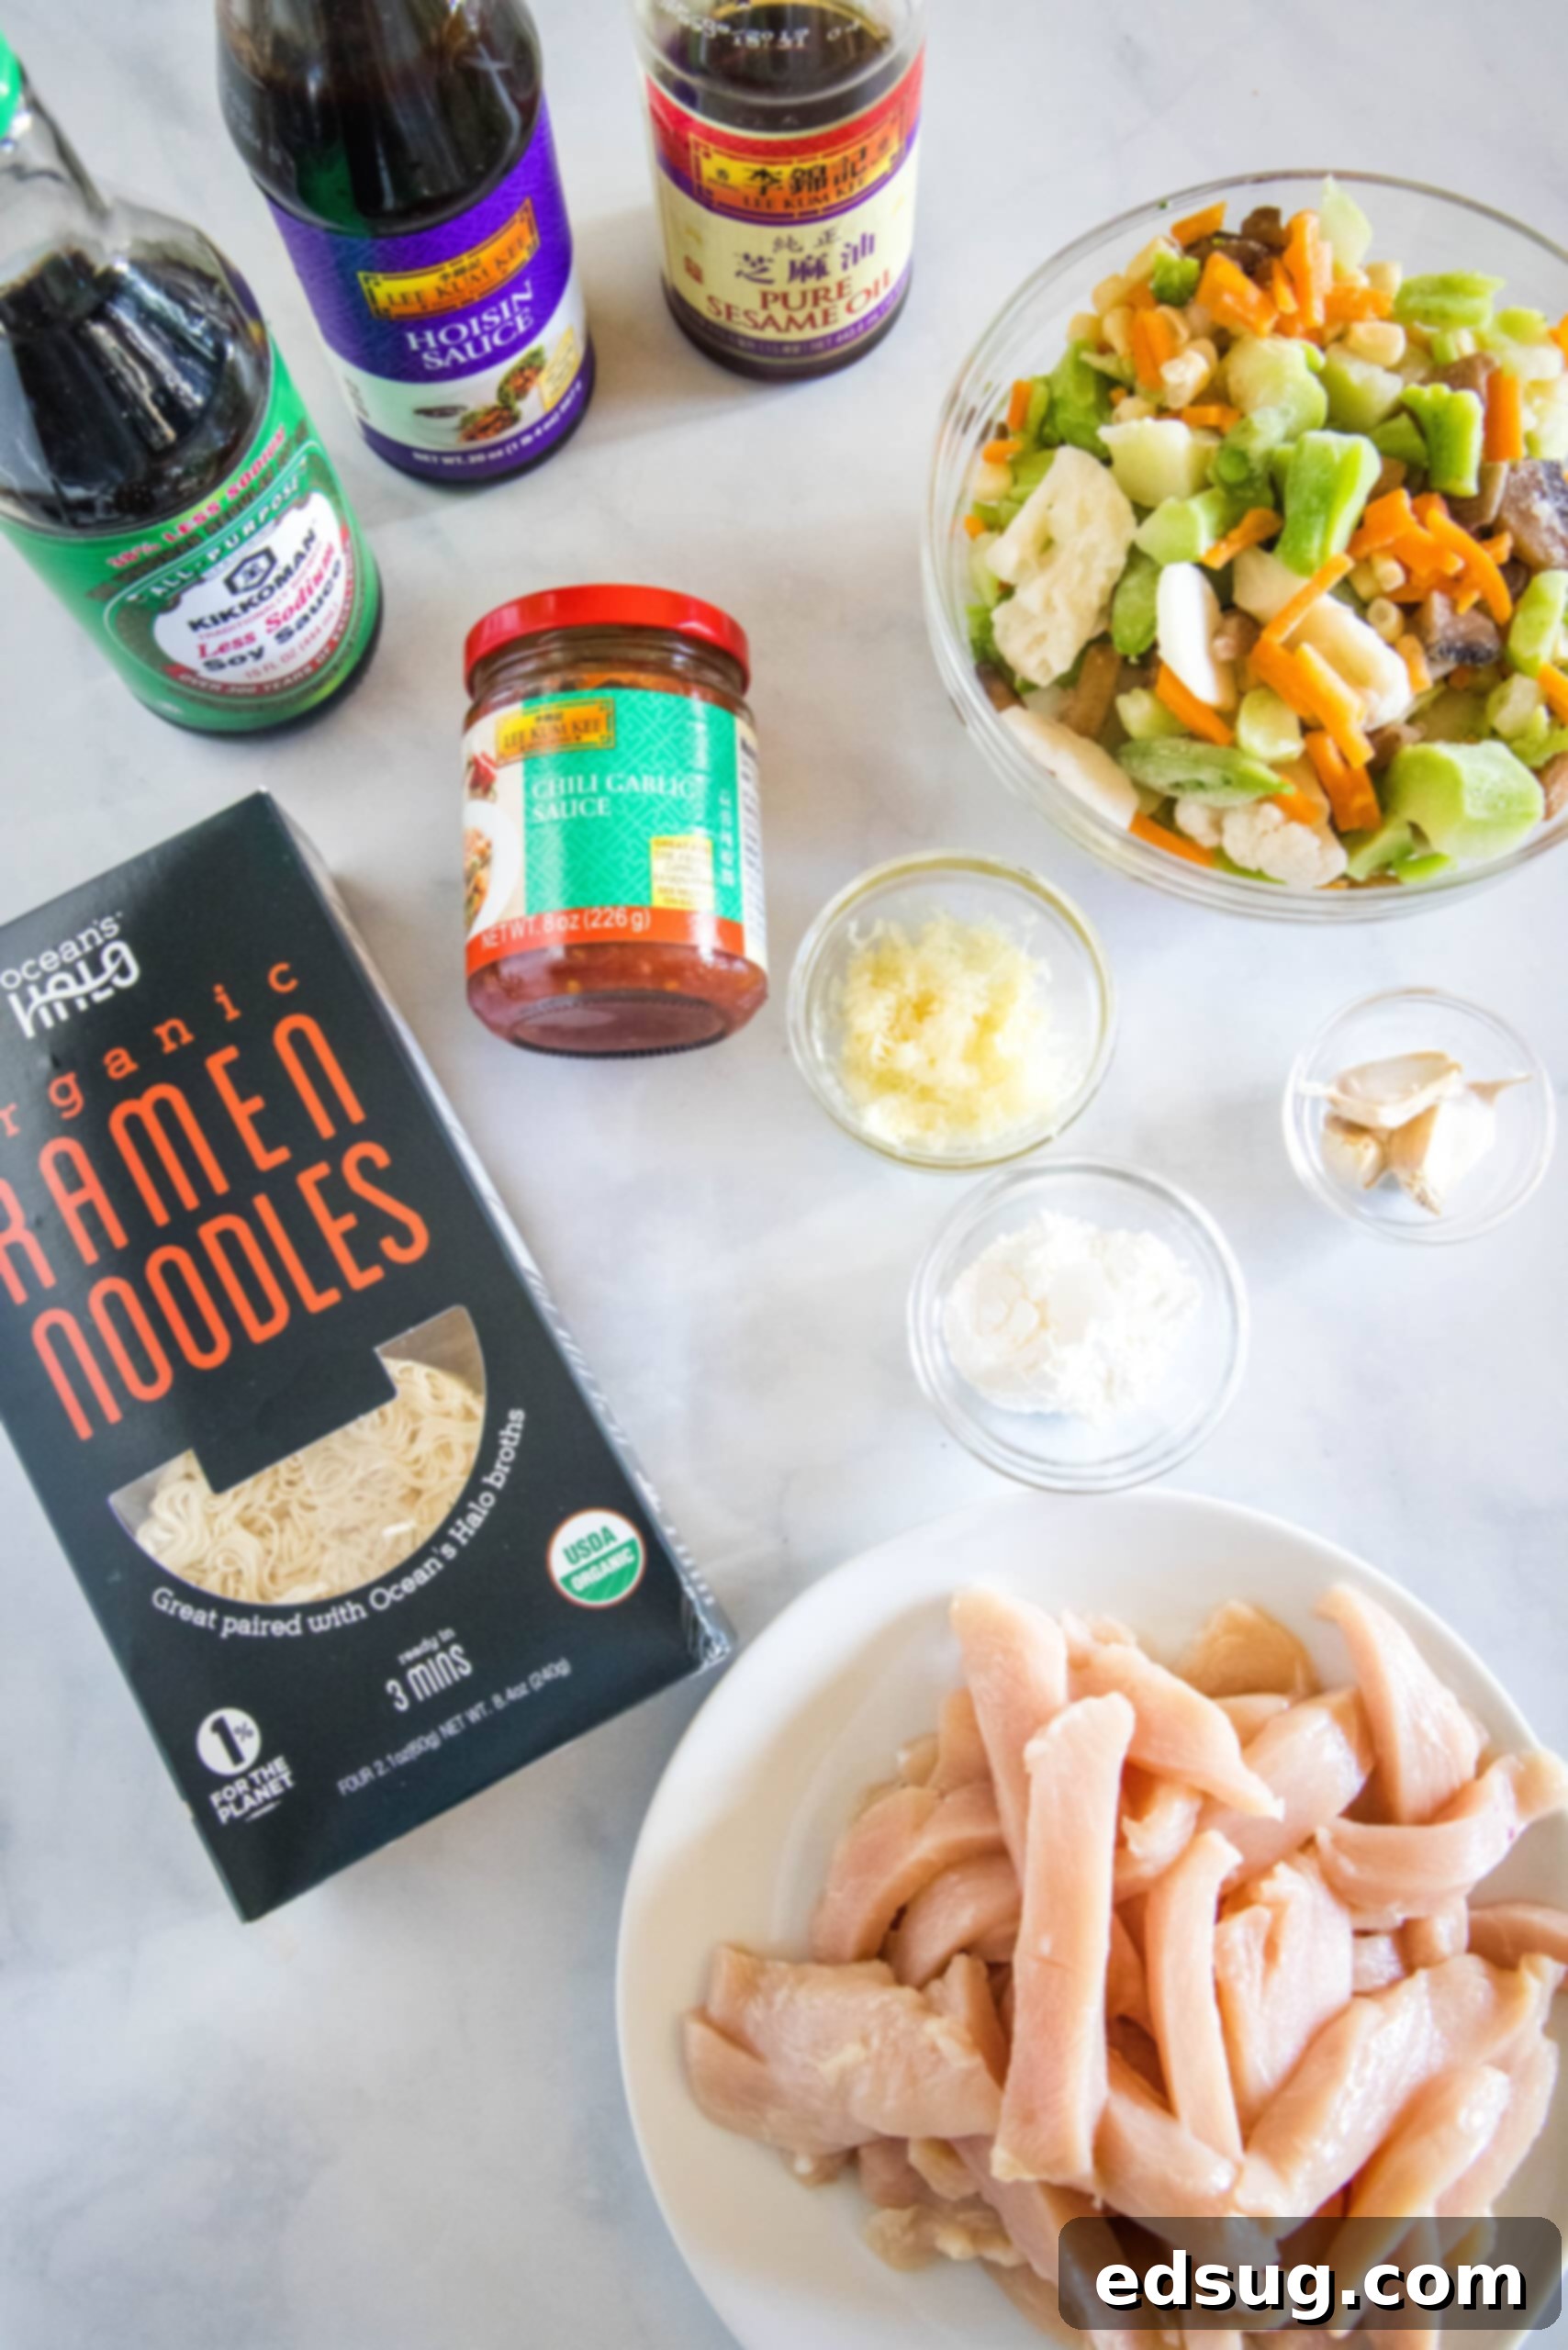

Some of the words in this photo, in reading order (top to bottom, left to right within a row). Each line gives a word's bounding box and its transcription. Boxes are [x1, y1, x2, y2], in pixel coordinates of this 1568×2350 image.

[744, 195, 774, 209] LEE
[783, 189, 830, 209] KUM
[734, 232, 875, 285] 芝麻油
[405, 279, 535, 352] HOISIN
[706, 295, 839, 334] SESAME
[759, 275, 852, 311] PURE
[421, 309, 535, 371] SAUCE
[162, 500, 220, 543] LESS
[187, 527, 317, 632] KIKKOMAN
[197, 631, 257, 659] Less
[263, 542, 335, 635] Sodium
[203, 645, 265, 673] Soy
[274, 559, 342, 644] Sauce
[532, 773, 599, 800] CHILI
[604, 773, 696, 799] GARLIC
[532, 796, 612, 822] SAUCE
[543, 913, 555, 933] 8
[583, 905, 628, 930] (226
[631, 908, 652, 934] g)
[0, 914, 120, 990] ocean's
[0, 960, 299, 1138] rganic
[31, 1141, 431, 1442] NOODLES
[151, 1587, 218, 1629] Great
[220, 1614, 303, 1639] paired
[308, 1600, 367, 1634] with
[369, 1544, 457, 1612] Ocean's
[448, 1489, 497, 1546] Halo
[483, 1407, 526, 1491] broths
[562, 1525, 618, 1566] USDA
[570, 1546, 635, 1591] ORGANIC
[398, 1635, 441, 1665] ready
[438, 1627, 456, 1643] in
[386, 1678, 410, 1712] 3
[209, 1714, 255, 1768] 1%
[337, 1765, 375, 1796] FOUR
[439, 1714, 466, 1740] NET
[465, 1700, 494, 1725] WT.
[208, 1777, 251, 1809] FOR
[247, 1754, 290, 1786] THE
[217, 1770, 296, 1825] PLANET
